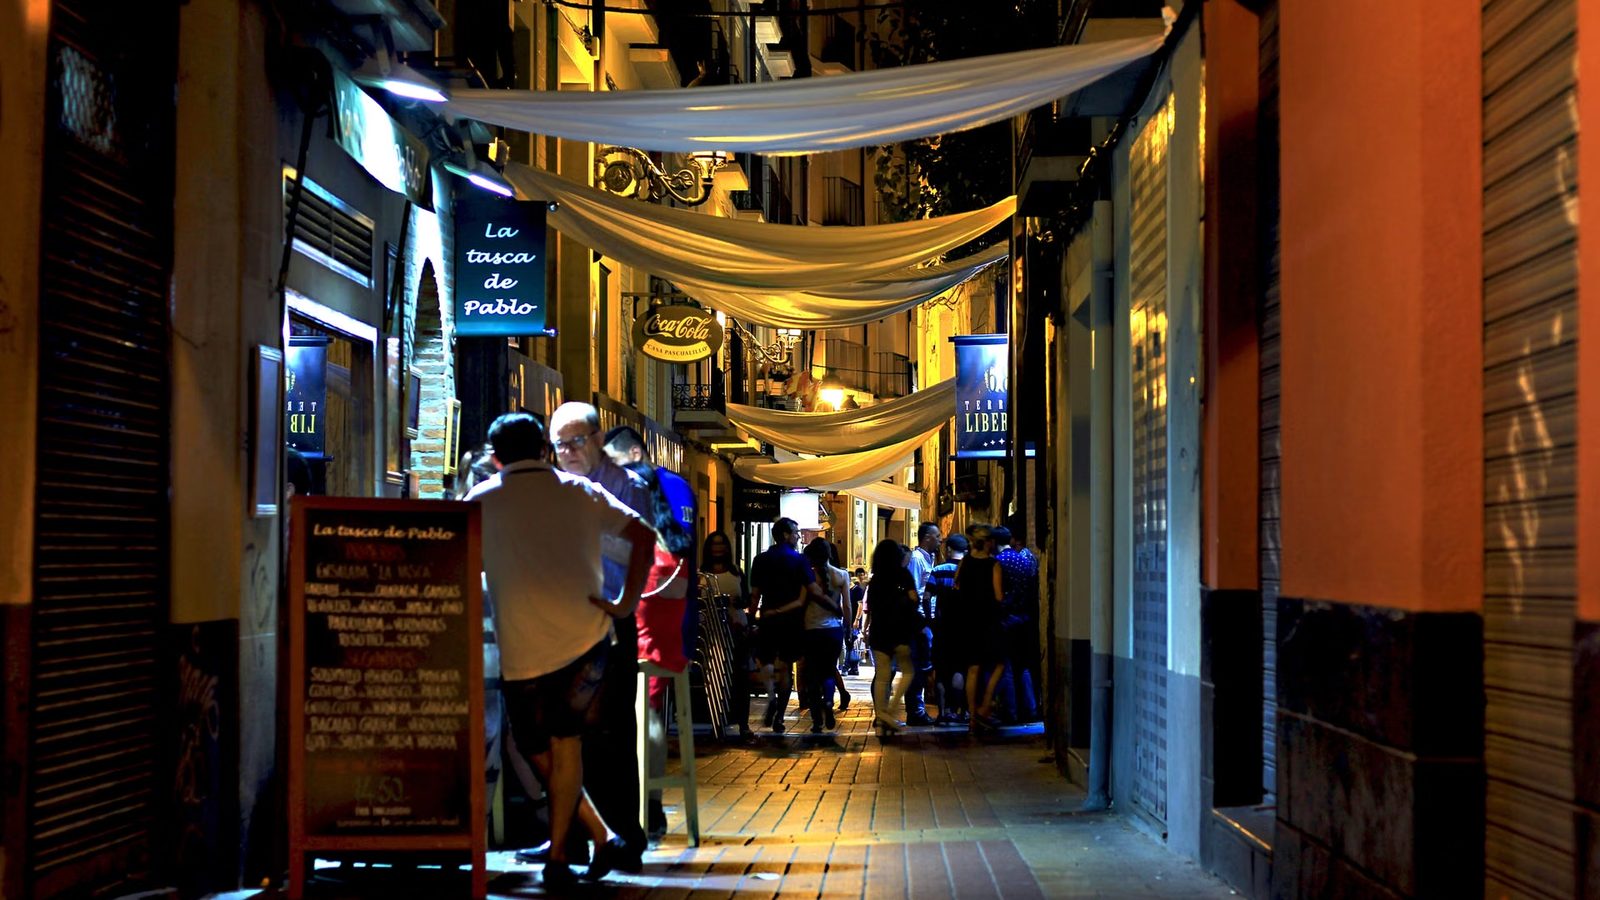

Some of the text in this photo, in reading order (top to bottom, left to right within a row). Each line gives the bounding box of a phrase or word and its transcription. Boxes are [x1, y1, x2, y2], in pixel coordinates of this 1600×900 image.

[485, 223, 519, 238] La
[466, 249, 536, 265] tasca
[484, 273, 518, 289] de
[464, 299, 537, 316] Pablo
[644, 313, 712, 340] Coca-Cola
[313, 523, 456, 541] La tasca de Pablo
